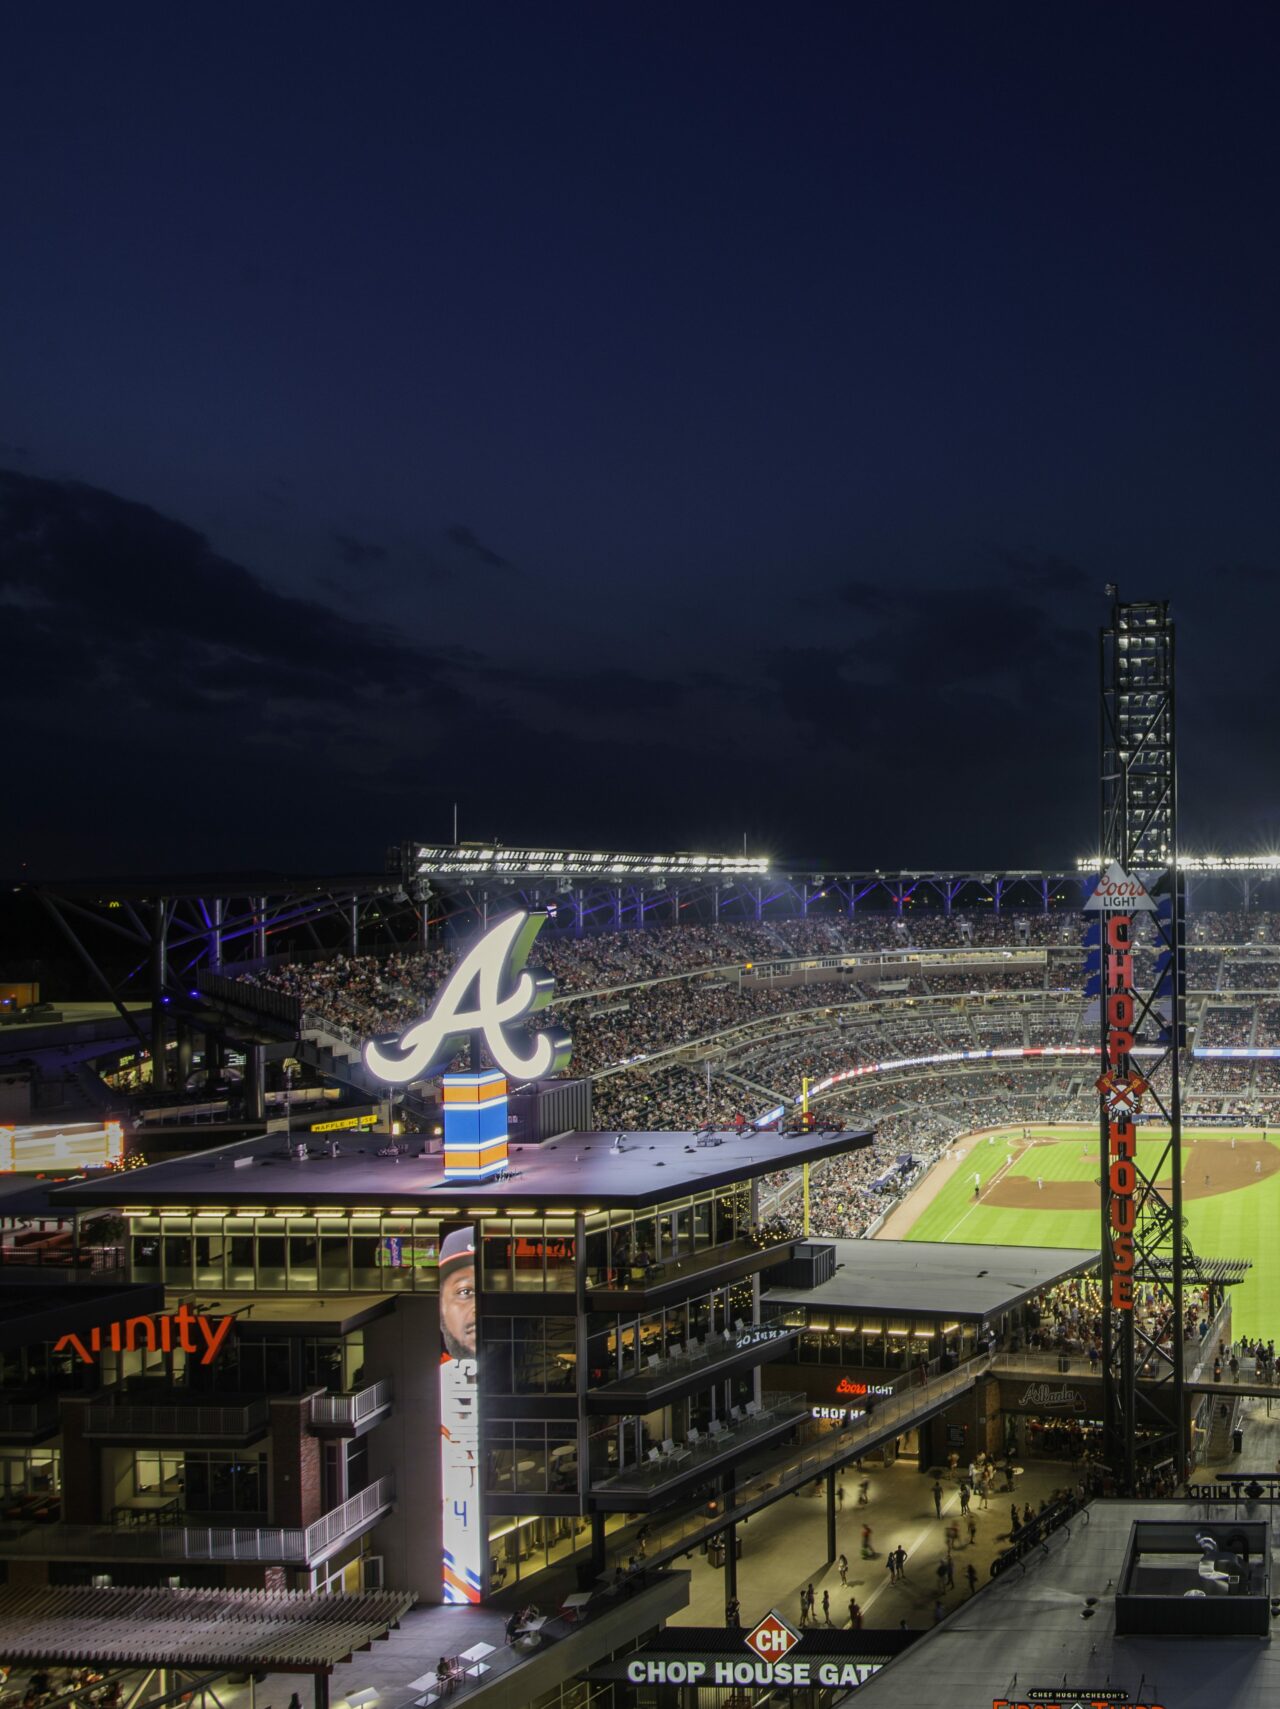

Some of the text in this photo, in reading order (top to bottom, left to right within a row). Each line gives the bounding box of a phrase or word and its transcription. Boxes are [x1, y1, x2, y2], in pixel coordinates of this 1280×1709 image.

[1094, 875, 1146, 896] Coors
[1103, 896, 1136, 907] LIGHT
[366, 911, 551, 1082] A
[1107, 915, 1134, 1064] CHOP
[315, 1121, 345, 1131] WAFFLE
[1110, 1122, 1137, 1310] HOUSE
[835, 1379, 893, 1395] Coors LIGHT
[812, 1407, 846, 1420] CHOP
[454, 1501, 467, 1527] 4
[756, 1630, 787, 1651] CH
[627, 1660, 706, 1684] CHOP
[715, 1661, 811, 1686] HOUSE
